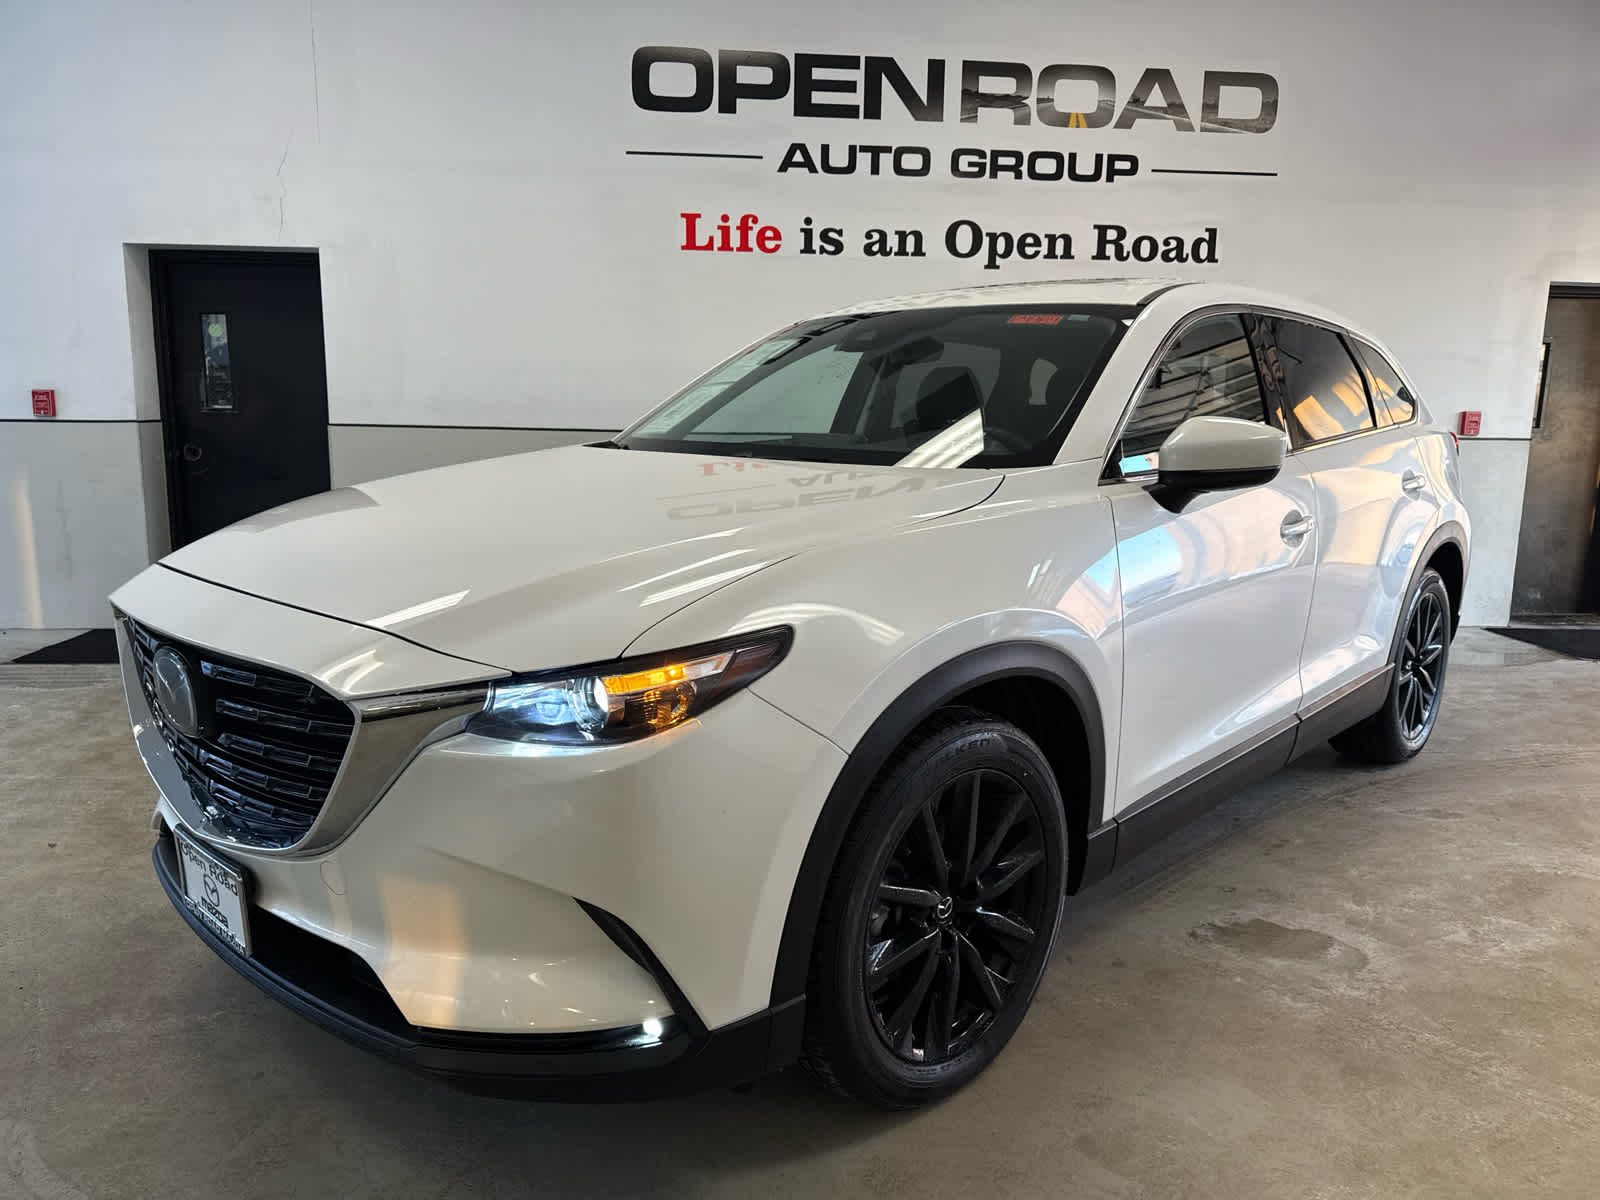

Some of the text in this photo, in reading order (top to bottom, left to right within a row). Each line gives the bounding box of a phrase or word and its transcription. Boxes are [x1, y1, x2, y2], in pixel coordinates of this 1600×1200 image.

[632, 46, 1279, 134] OPEN ROAD
[777, 143, 1139, 183] AUTO GROUP
[680, 213, 1218, 270] Life is an Open Road
[208, 861, 239, 897] Road
